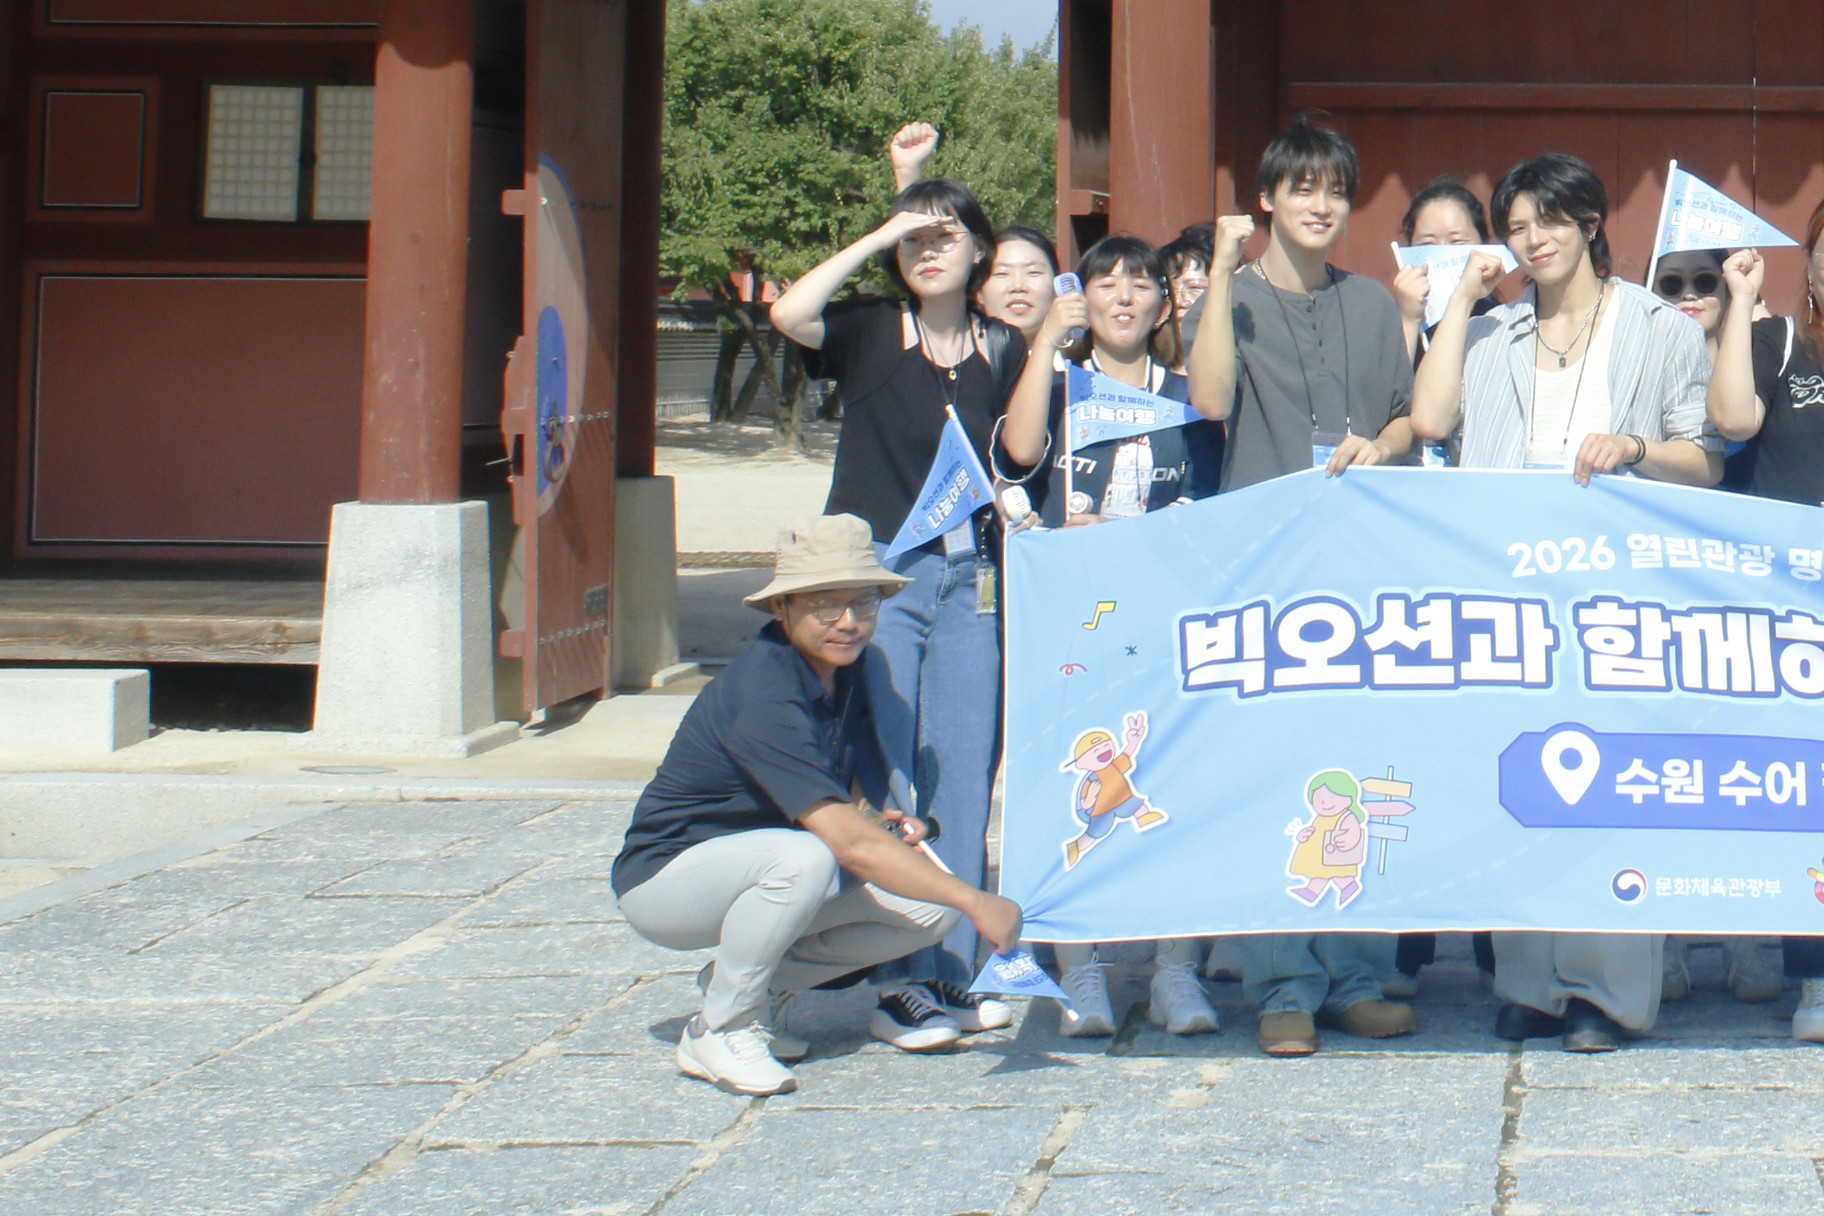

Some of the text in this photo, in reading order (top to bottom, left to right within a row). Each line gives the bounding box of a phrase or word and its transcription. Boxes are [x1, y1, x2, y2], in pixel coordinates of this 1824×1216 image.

[1078, 403, 1157, 426] 나눔여행
[926, 465, 972, 532] 나눔여행
[1506, 535, 1616, 578] 2026
[1626, 533, 1776, 577] 열린관광
[1179, 592, 1557, 697] 빅오션과
[1615, 758, 1705, 805] 수원
[1718, 759, 1807, 807] 수어
[1654, 876, 1782, 899] 문화체육관광부
